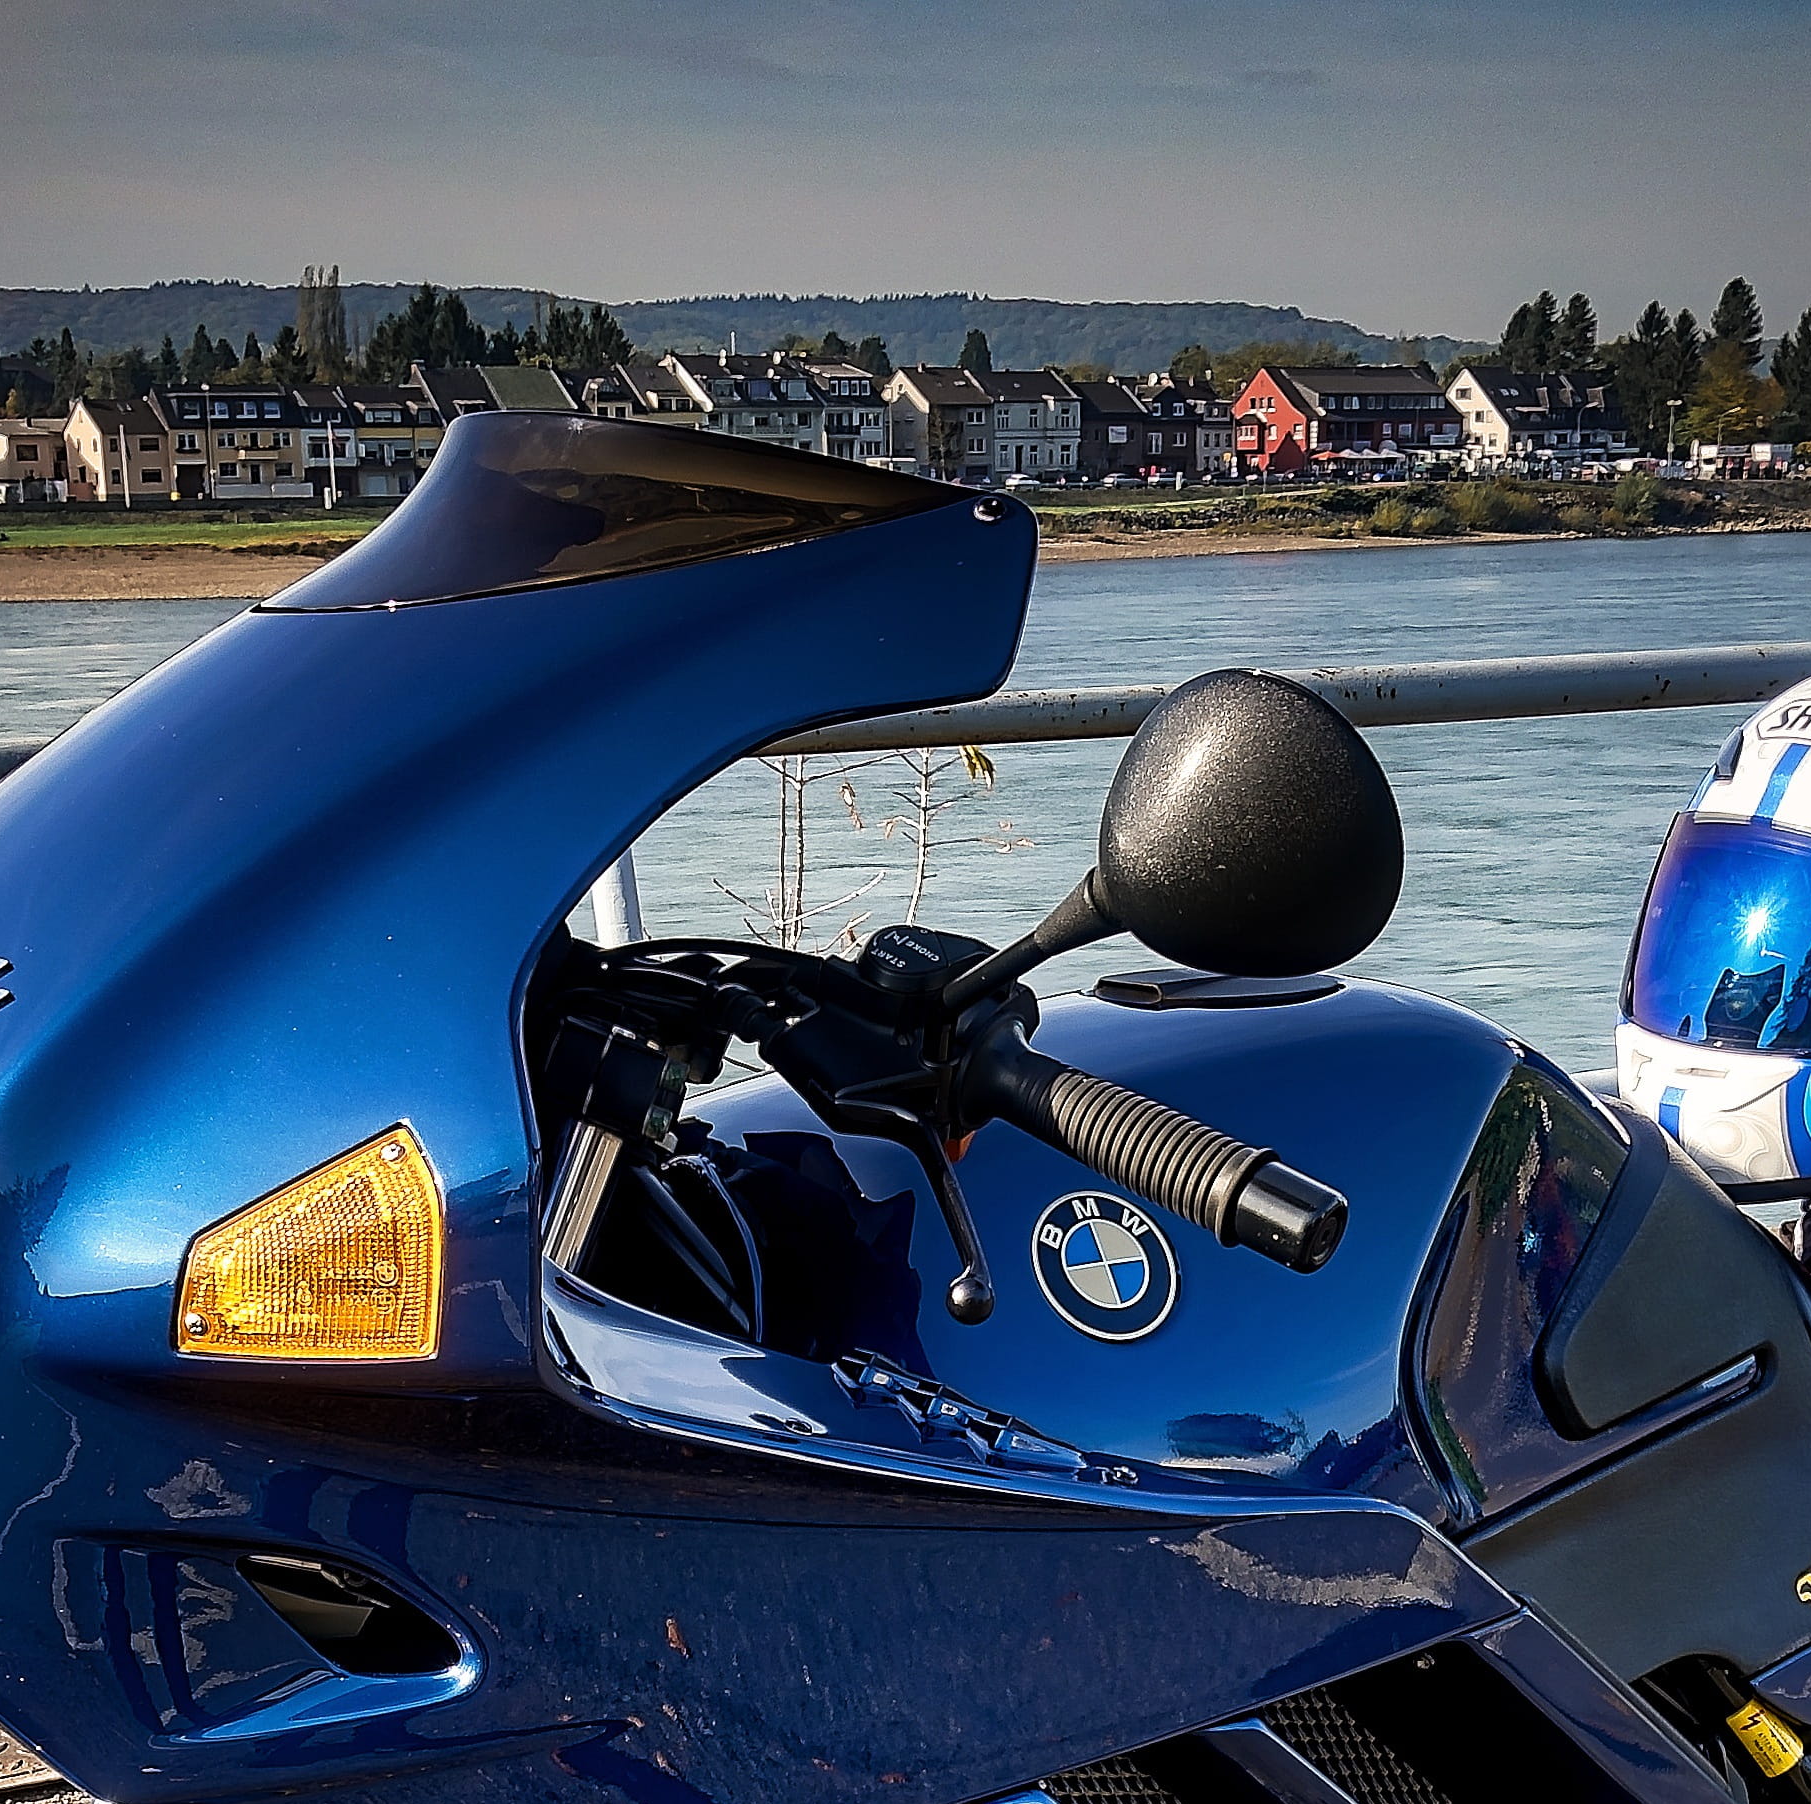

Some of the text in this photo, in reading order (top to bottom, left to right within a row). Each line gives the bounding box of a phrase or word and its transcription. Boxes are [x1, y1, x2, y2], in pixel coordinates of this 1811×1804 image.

[869, 947, 907, 969] START
[905, 939, 941, 963] CHOKE
[1039, 1196, 1150, 1251] BMW
